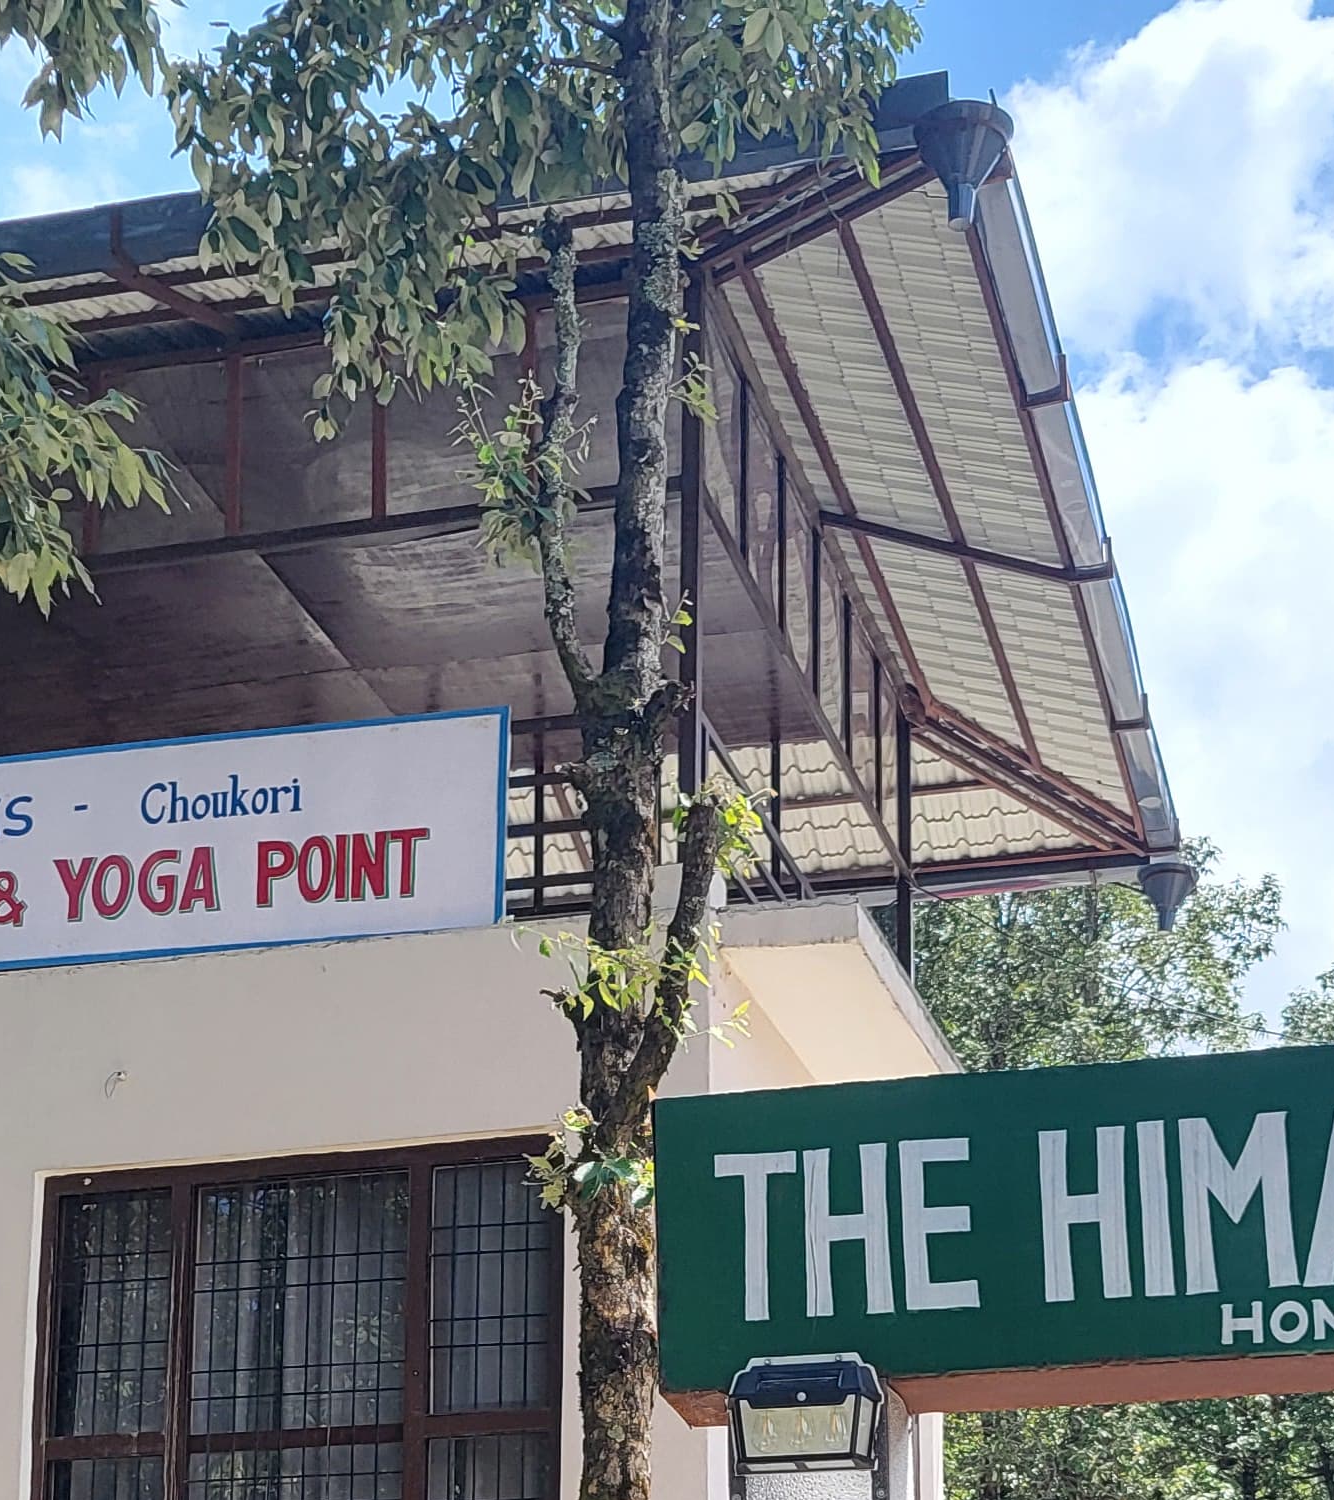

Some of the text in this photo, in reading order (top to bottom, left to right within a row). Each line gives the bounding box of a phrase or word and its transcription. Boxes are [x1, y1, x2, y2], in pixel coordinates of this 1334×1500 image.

[141, 774, 302, 825] Choukori
[53, 846, 219, 922] YOGA
[255, 828, 430, 909] POINT
[714, 1136, 980, 1320] THE
